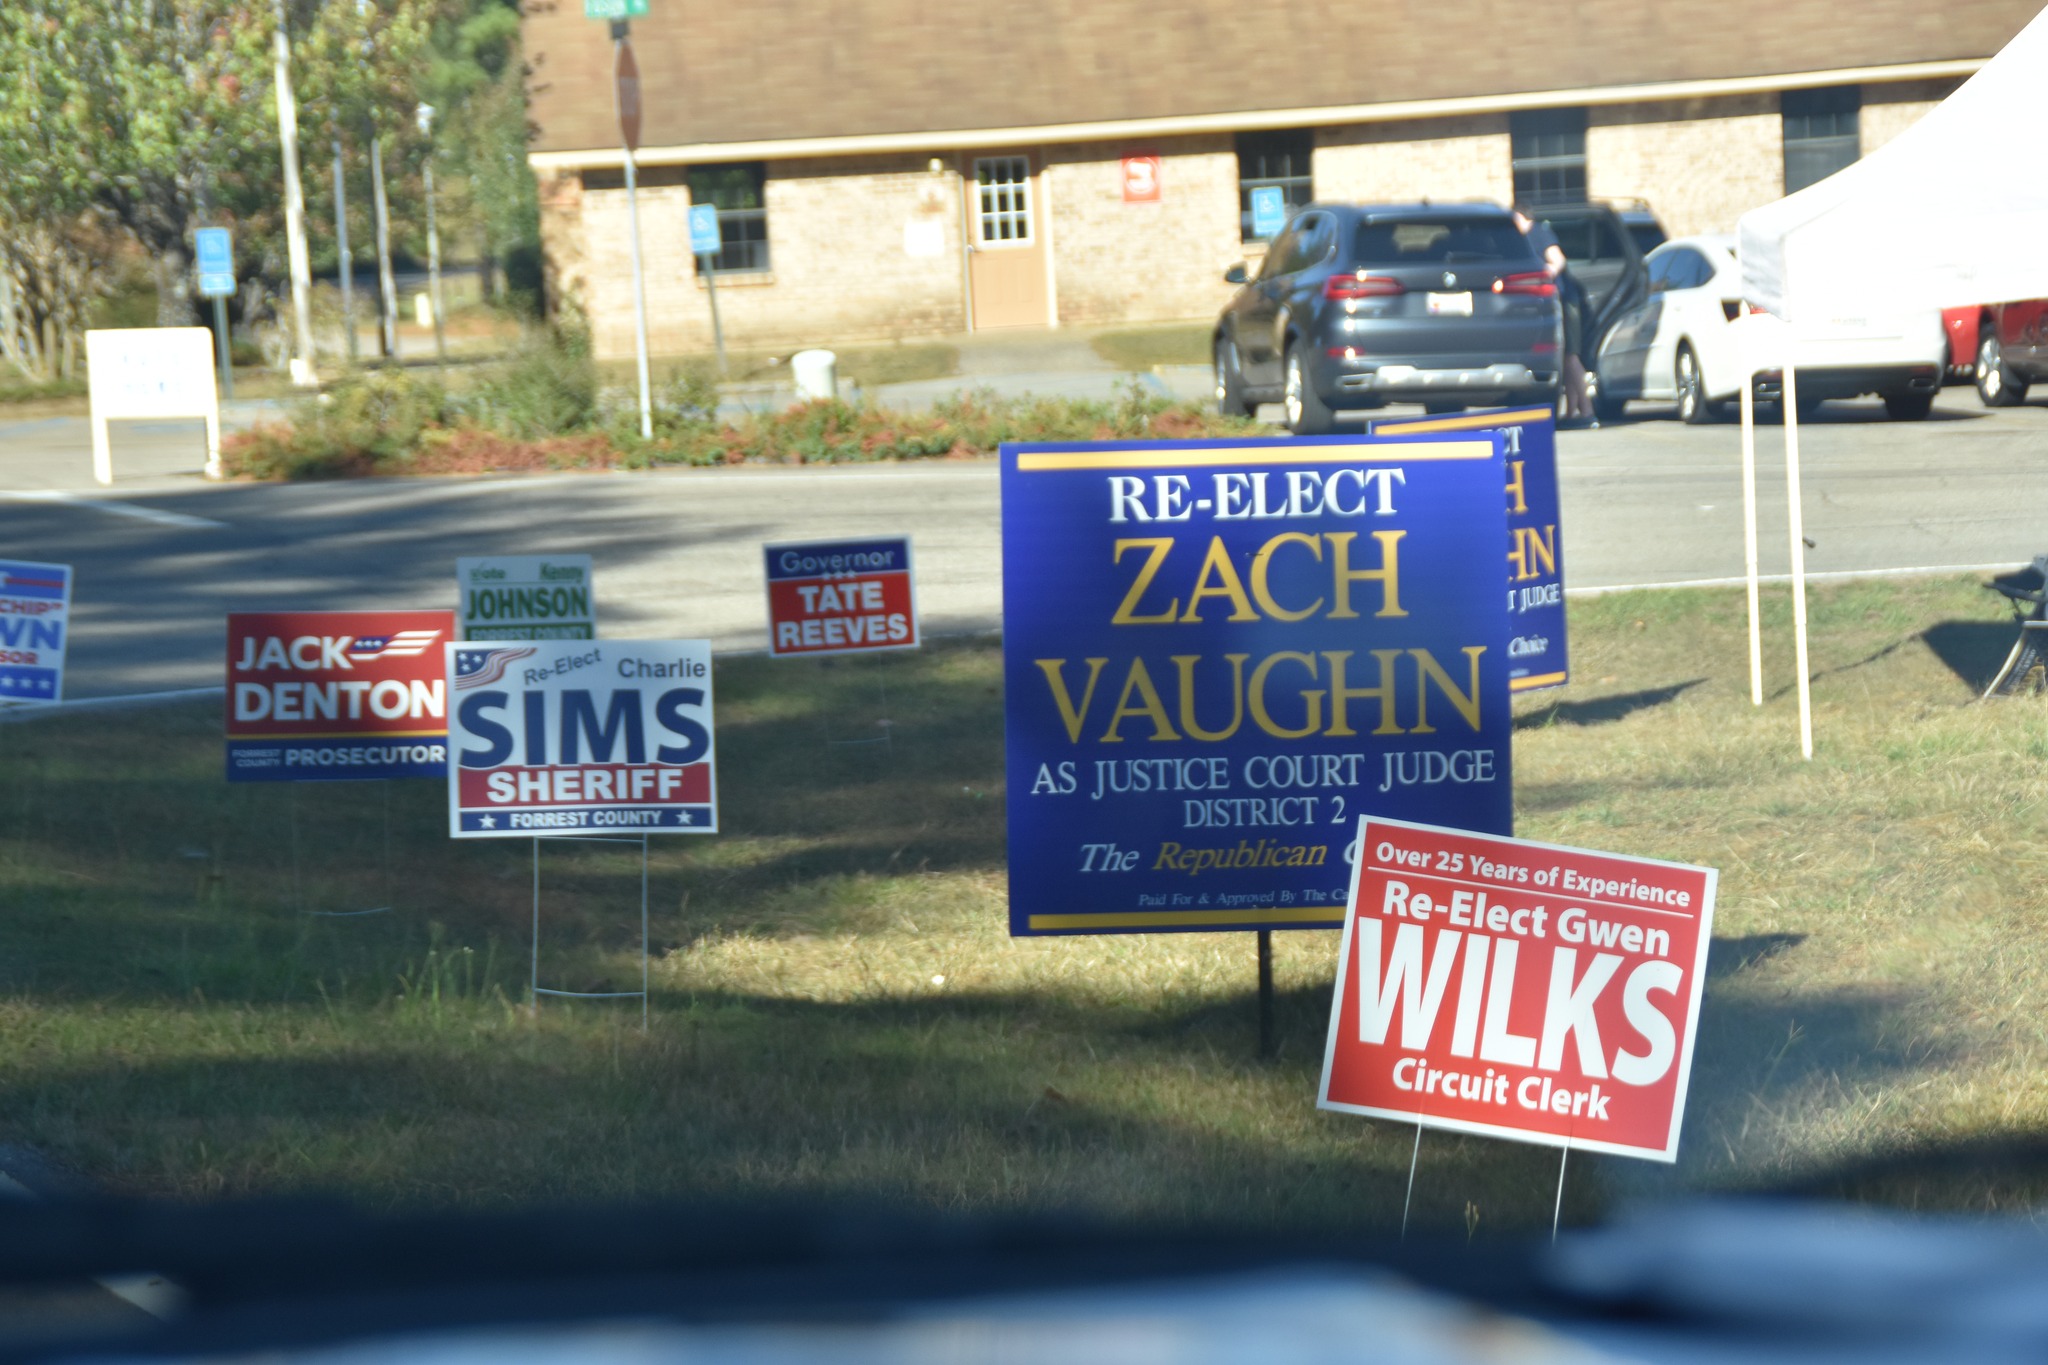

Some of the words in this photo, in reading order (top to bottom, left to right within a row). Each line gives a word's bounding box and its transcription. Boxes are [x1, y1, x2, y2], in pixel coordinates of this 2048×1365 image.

[1108, 467, 1405, 522] RE-ELECT
[779, 549, 894, 573] Governor
[1111, 529, 1409, 625] ZACH
[466, 587, 588, 620] JOHNSON
[797, 581, 884, 613] TATE
[1519, 582, 1560, 614] JUDGE
[777, 613, 908, 648] REEVES
[235, 635, 353, 671] JACK
[524, 648, 602, 686] Re-Elect
[617, 657, 706, 679] Charlie
[234, 679, 445, 722] DENTON
[1033, 645, 1487, 744] VAUGHN
[457, 687, 710, 768] SIMS
[285, 745, 446, 767] PROSECUTOR
[1030, 761, 1077, 794] AS
[1091, 757, 1230, 801] JUSTICE
[1244, 753, 1365, 788] COURT
[1378, 749, 1496, 792] JUDGE
[487, 769, 683, 803] SHERIFF
[510, 811, 589, 828] FORREST
[592, 810, 662, 825] COUNTY
[1183, 797, 1319, 828] DISTRICT
[1331, 795, 1347, 824] 2
[1079, 842, 1140, 873] The
[1152, 838, 1327, 876] Republican
[1376, 841, 1431, 868] Over
[1435, 850, 1464, 873] 25
[1469, 854, 1528, 883] Years
[1533, 866, 1560, 887] of
[1563, 868, 1691, 907] Experience
[1139, 893, 1167, 906] Paid
[1172, 893, 1194, 905] For
[1216, 890, 1276, 906] Approved
[1281, 890, 1297, 903] By
[1303, 889, 1328, 901] The
[1383, 880, 1548, 938] Re-Elect
[1557, 907, 1670, 957] Gwen
[1358, 916, 1684, 1086] WILKS
[1392, 1056, 1510, 1106] Circuit
[1517, 1075, 1611, 1121] Clerk
